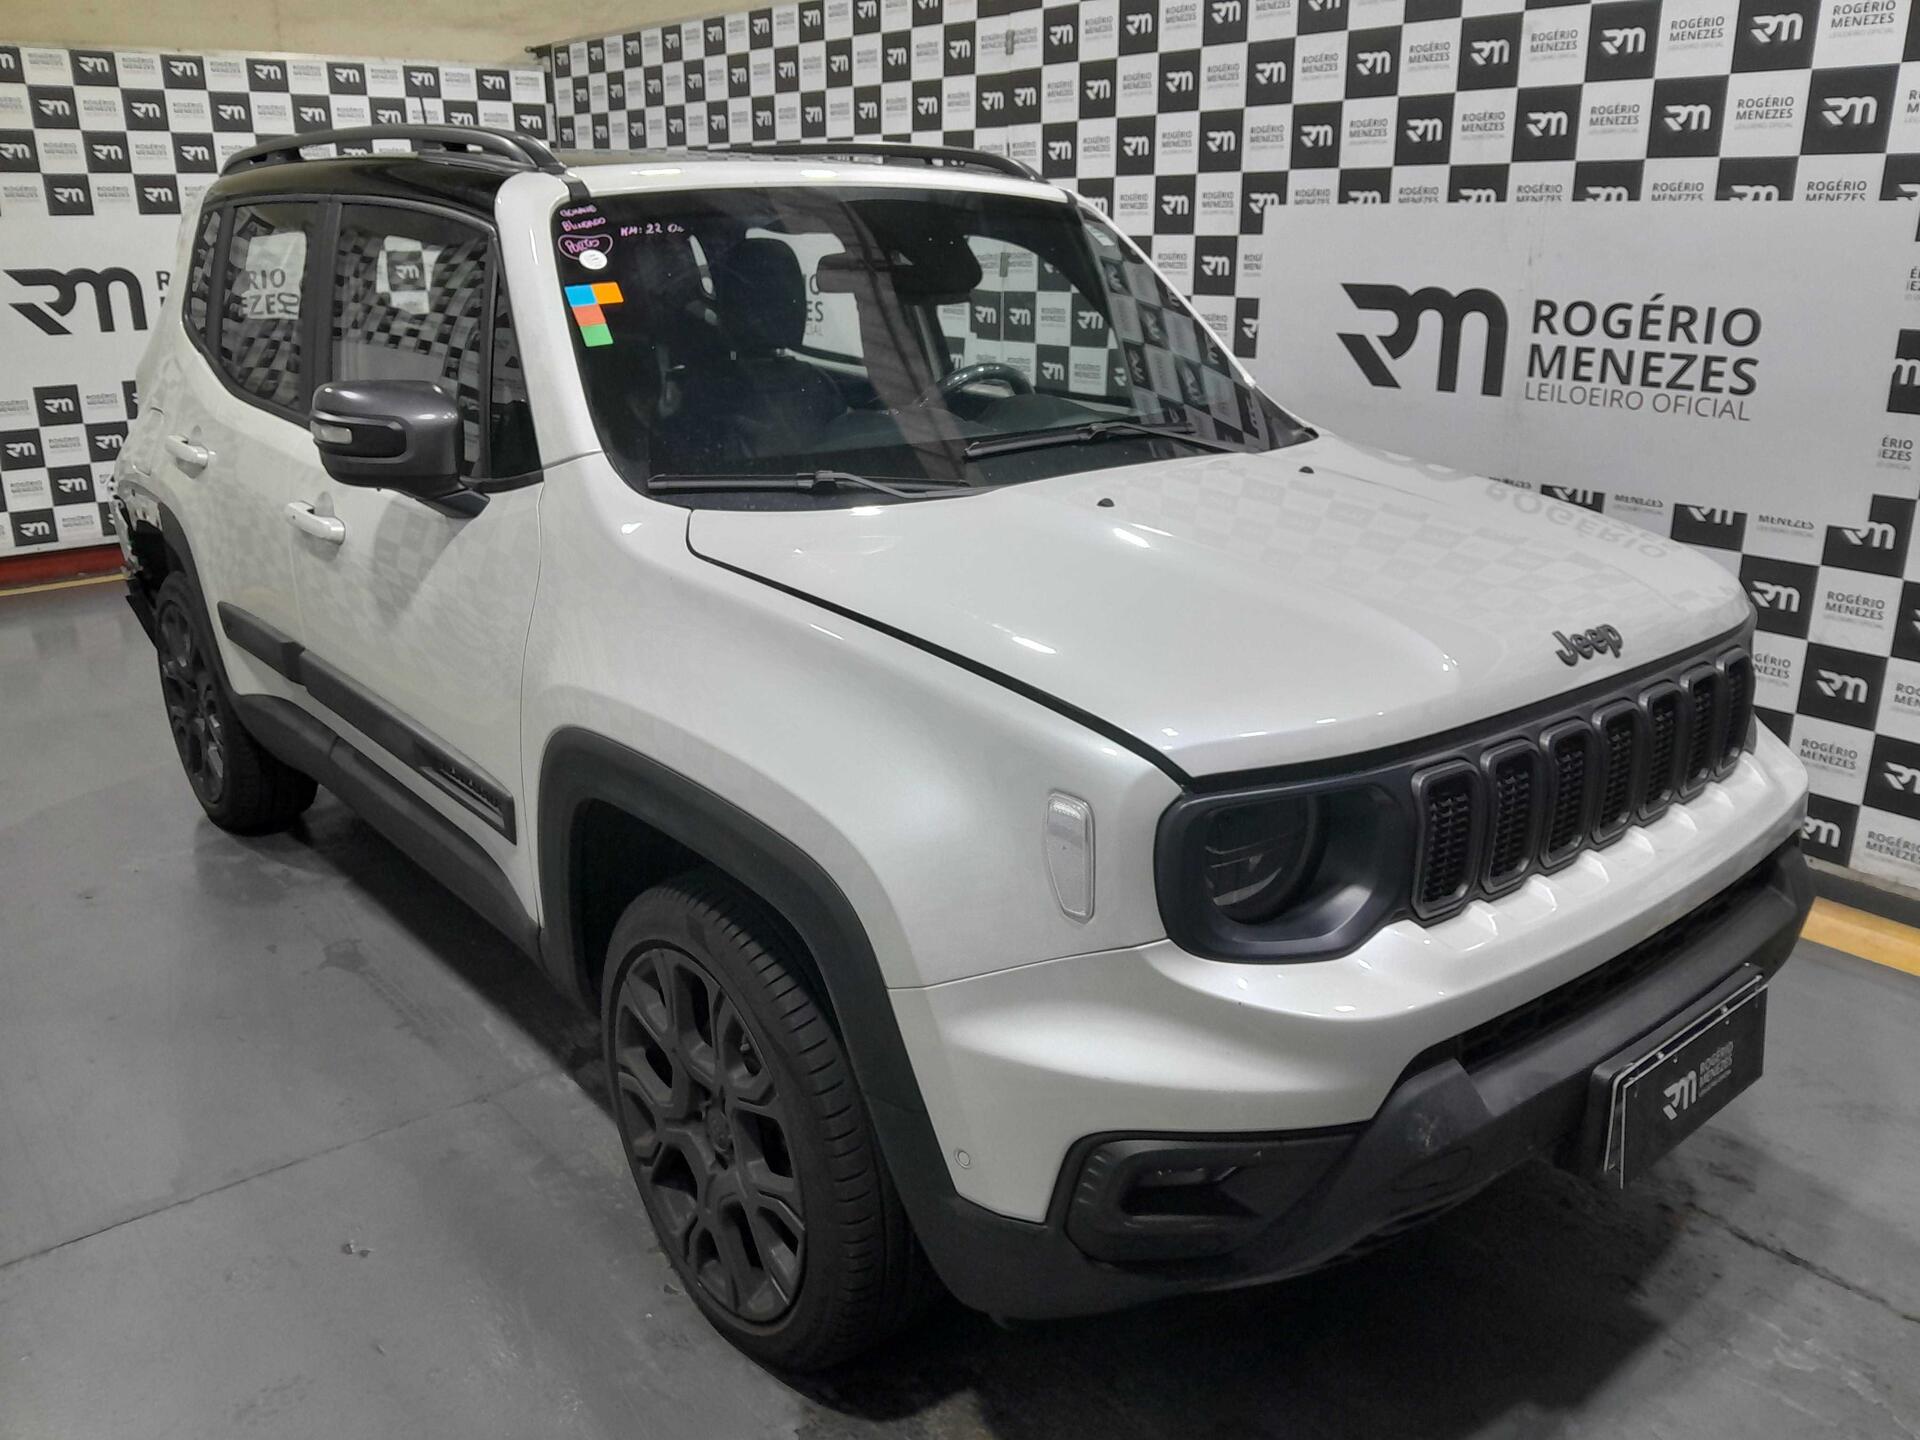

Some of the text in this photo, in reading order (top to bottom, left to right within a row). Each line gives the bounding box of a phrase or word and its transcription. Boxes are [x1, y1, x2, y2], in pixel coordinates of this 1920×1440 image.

[1833, 0, 1896, 16] ROGÉRIO
[1671, 16, 1724, 30] ROGÉRIO
[1831, 12, 1894, 28] MENEZES
[1531, 30, 1578, 42] ROGÉRIO
[1670, 28, 1723, 41] MENEZES
[1530, 40, 1577, 52] MENEZES
[1738, 96, 1794, 108] ROGÉRIO
[1590, 104, 1640, 115] ROGÉRIO
[1736, 108, 1792, 120] MENEZES
[1462, 112, 1505, 122] ROGÉRIO
[1590, 115, 1639, 126] MENEZES
[1462, 122, 1504, 132] MENEZES
[1517, 184, 1562, 194] ROGÉRIO
[1652, 182, 1704, 192] ROGÉRIO
[1807, 180, 1866, 191] ROGÉRIO
[1532, 293, 1761, 347] ROGÉRIO
[1527, 343, 1760, 396] MENEZES
[1525, 381, 1750, 421] LEILOEIRO OFICIAL
[1827, 591, 1884, 609] ROGÉRIO
[1825, 602, 1883, 620] MENEZES
[1552, 624, 1623, 666] Jeep
[1802, 738, 1857, 760] ROGÉRIO
[1800, 748, 1856, 770] MENEZES
